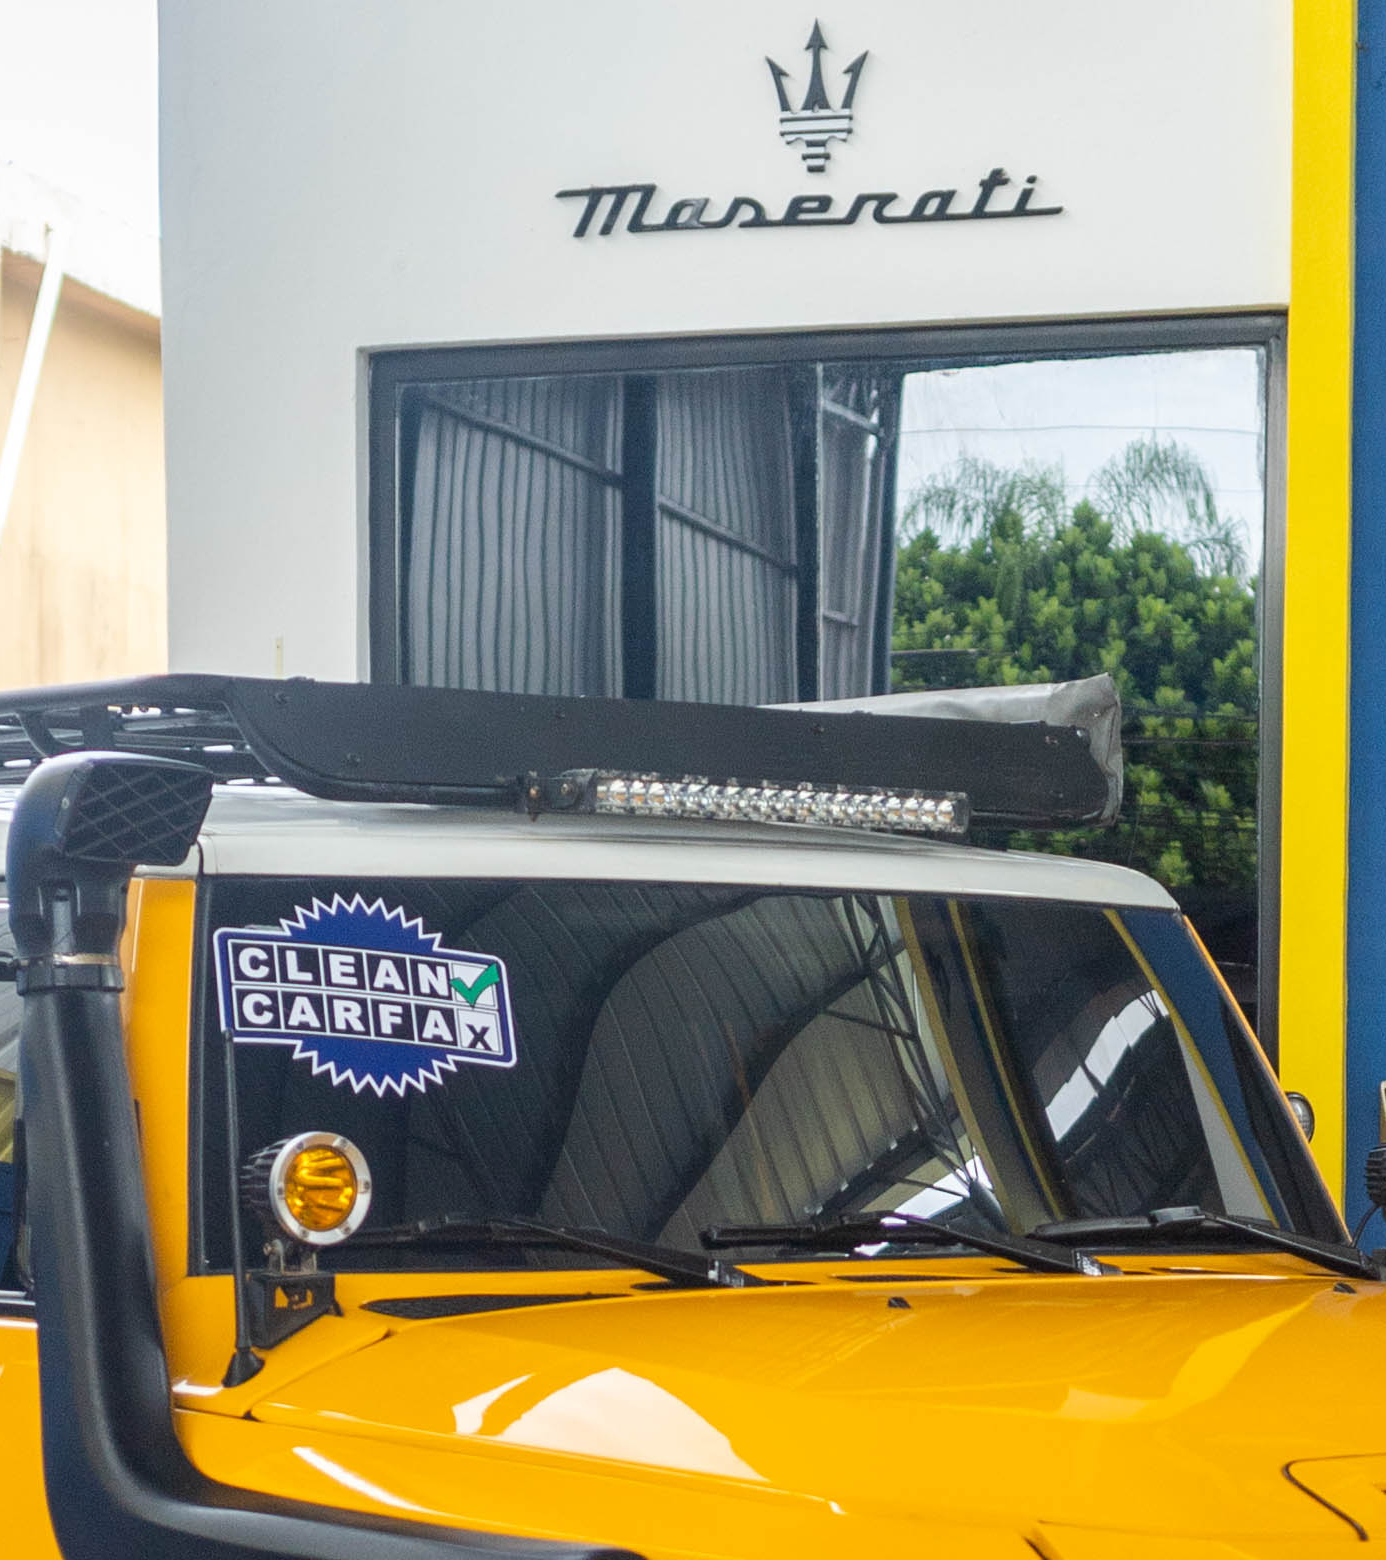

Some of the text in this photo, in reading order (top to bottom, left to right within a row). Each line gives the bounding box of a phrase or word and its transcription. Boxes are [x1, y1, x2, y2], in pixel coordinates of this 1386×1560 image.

[555, 167, 1064, 239] Maserati
[238, 946, 450, 997] CLEAN
[242, 993, 493, 1051] CARFAX
